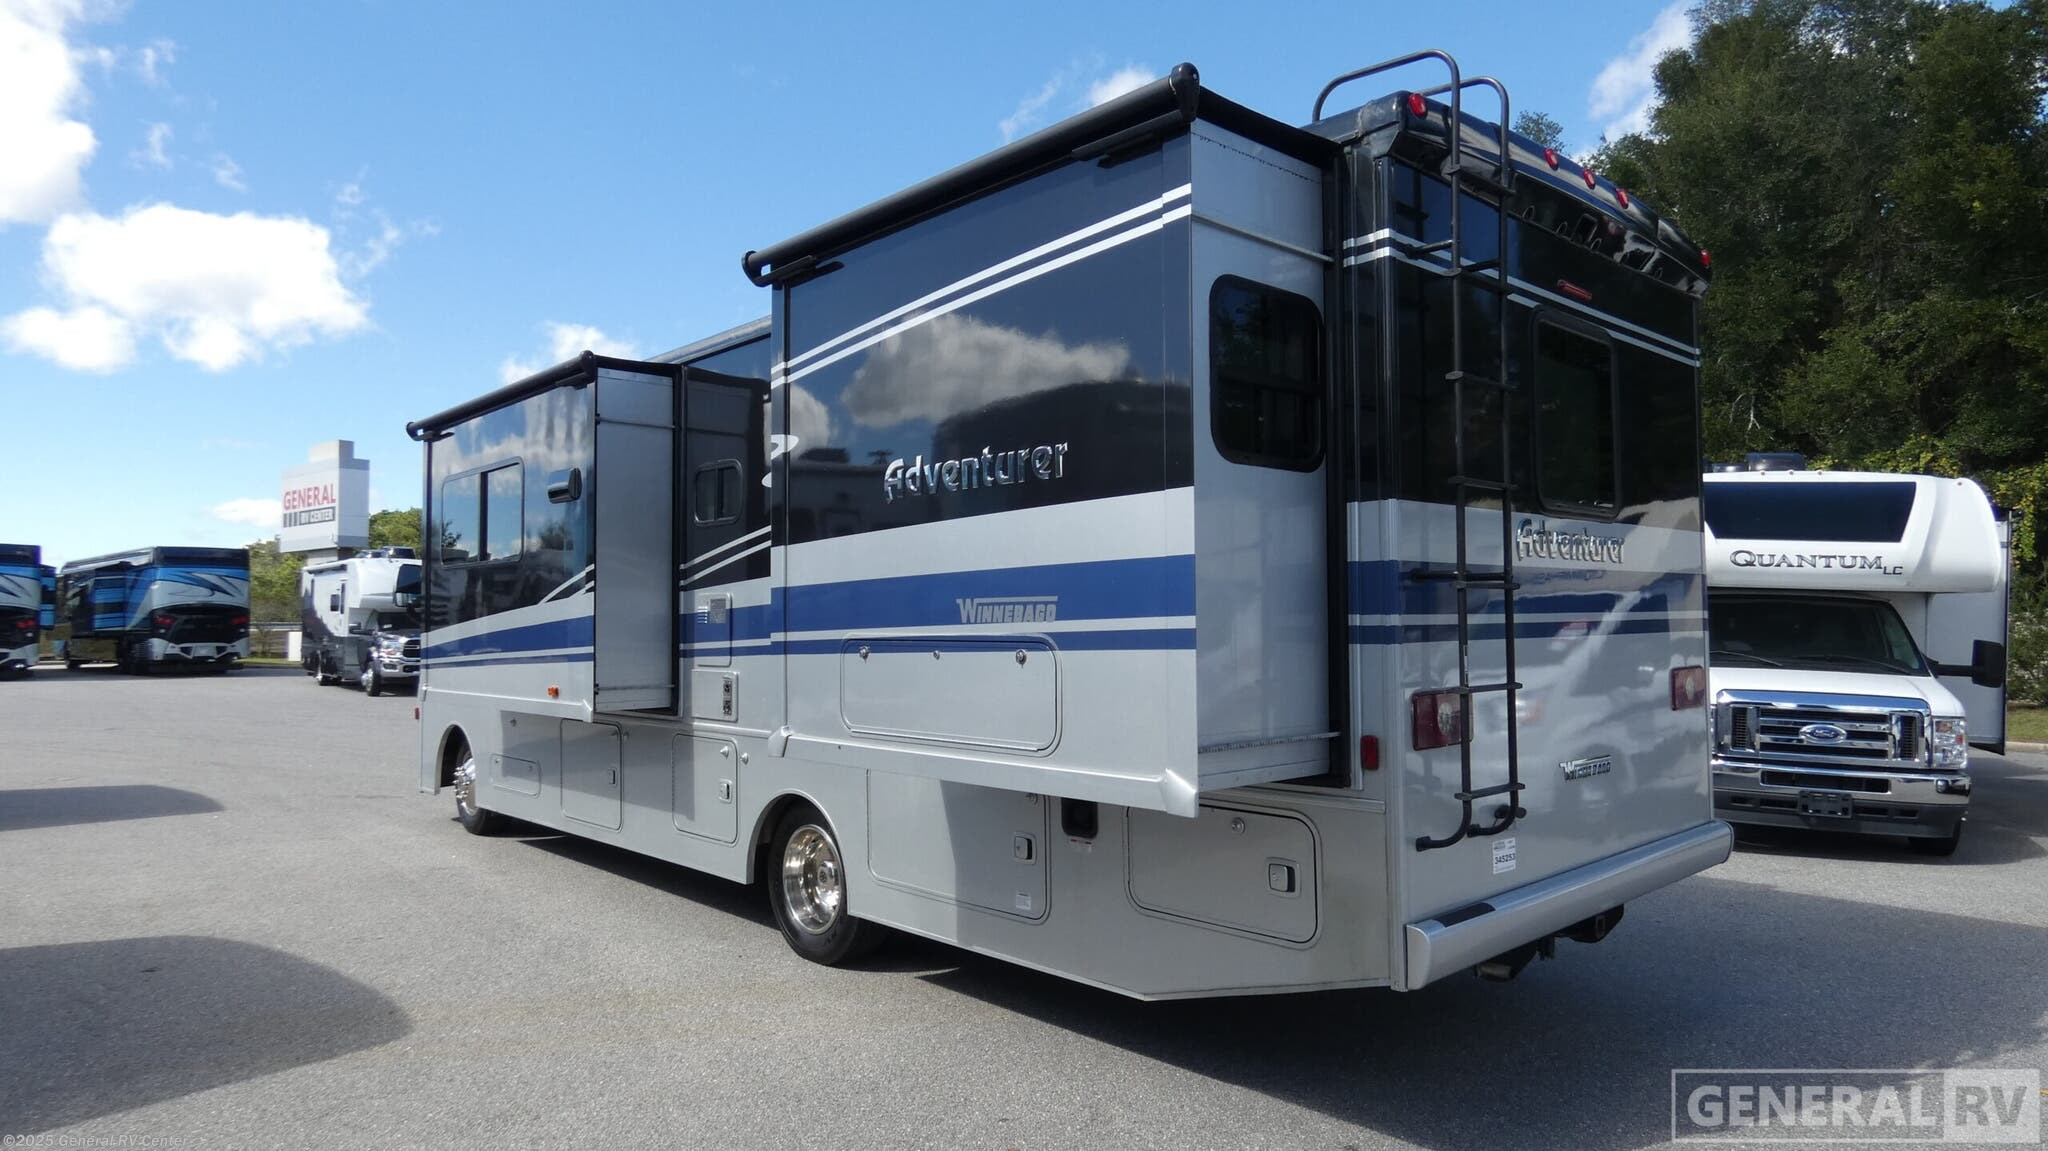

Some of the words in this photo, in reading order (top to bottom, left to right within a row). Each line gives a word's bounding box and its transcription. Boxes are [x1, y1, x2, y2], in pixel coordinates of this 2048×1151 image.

[884, 441, 1068, 504] Adventurer
[283, 483, 337, 511] GENERAL
[1516, 518, 1625, 564] Adventurer
[1729, 549, 1883, 570] QUANTUM
[1883, 566, 1904, 576] LC
[956, 596, 1058, 624] WINNEBAGO
